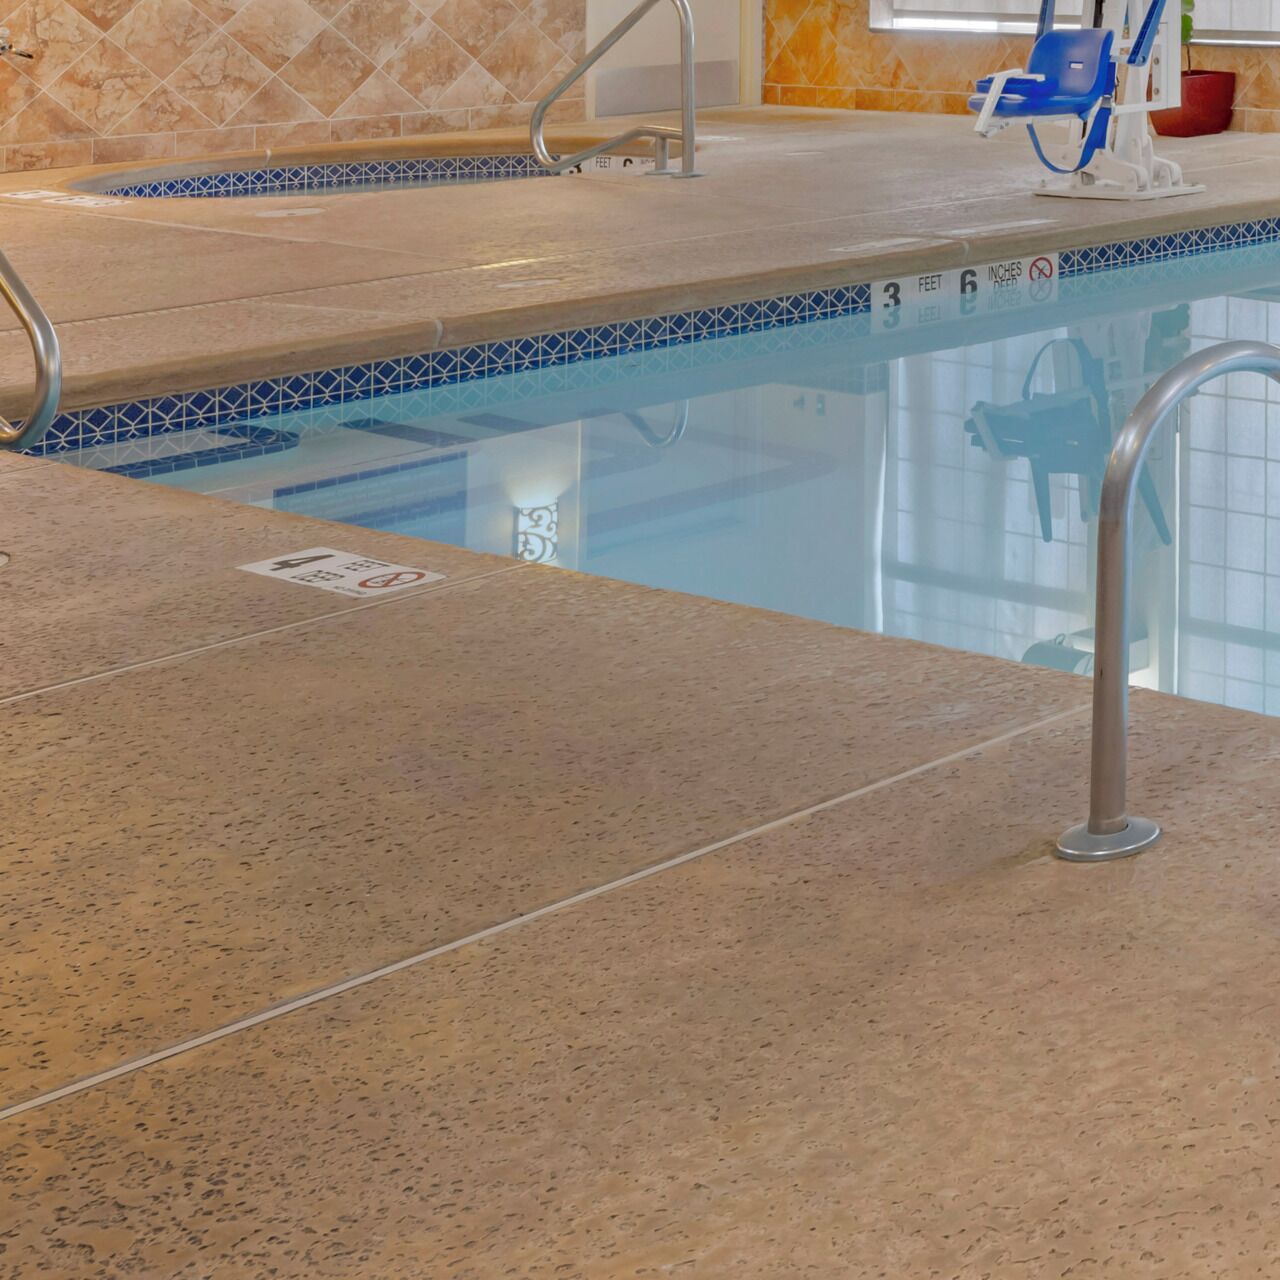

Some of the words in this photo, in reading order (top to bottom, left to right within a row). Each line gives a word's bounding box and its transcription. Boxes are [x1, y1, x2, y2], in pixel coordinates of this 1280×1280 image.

[596, 156, 611, 168] FEET
[988, 261, 1022, 280] INCHES
[918, 274, 942, 293] FEET
[960, 269, 977, 295] 6
[883, 282, 901, 308] 3
[269, 554, 336, 571] 4
